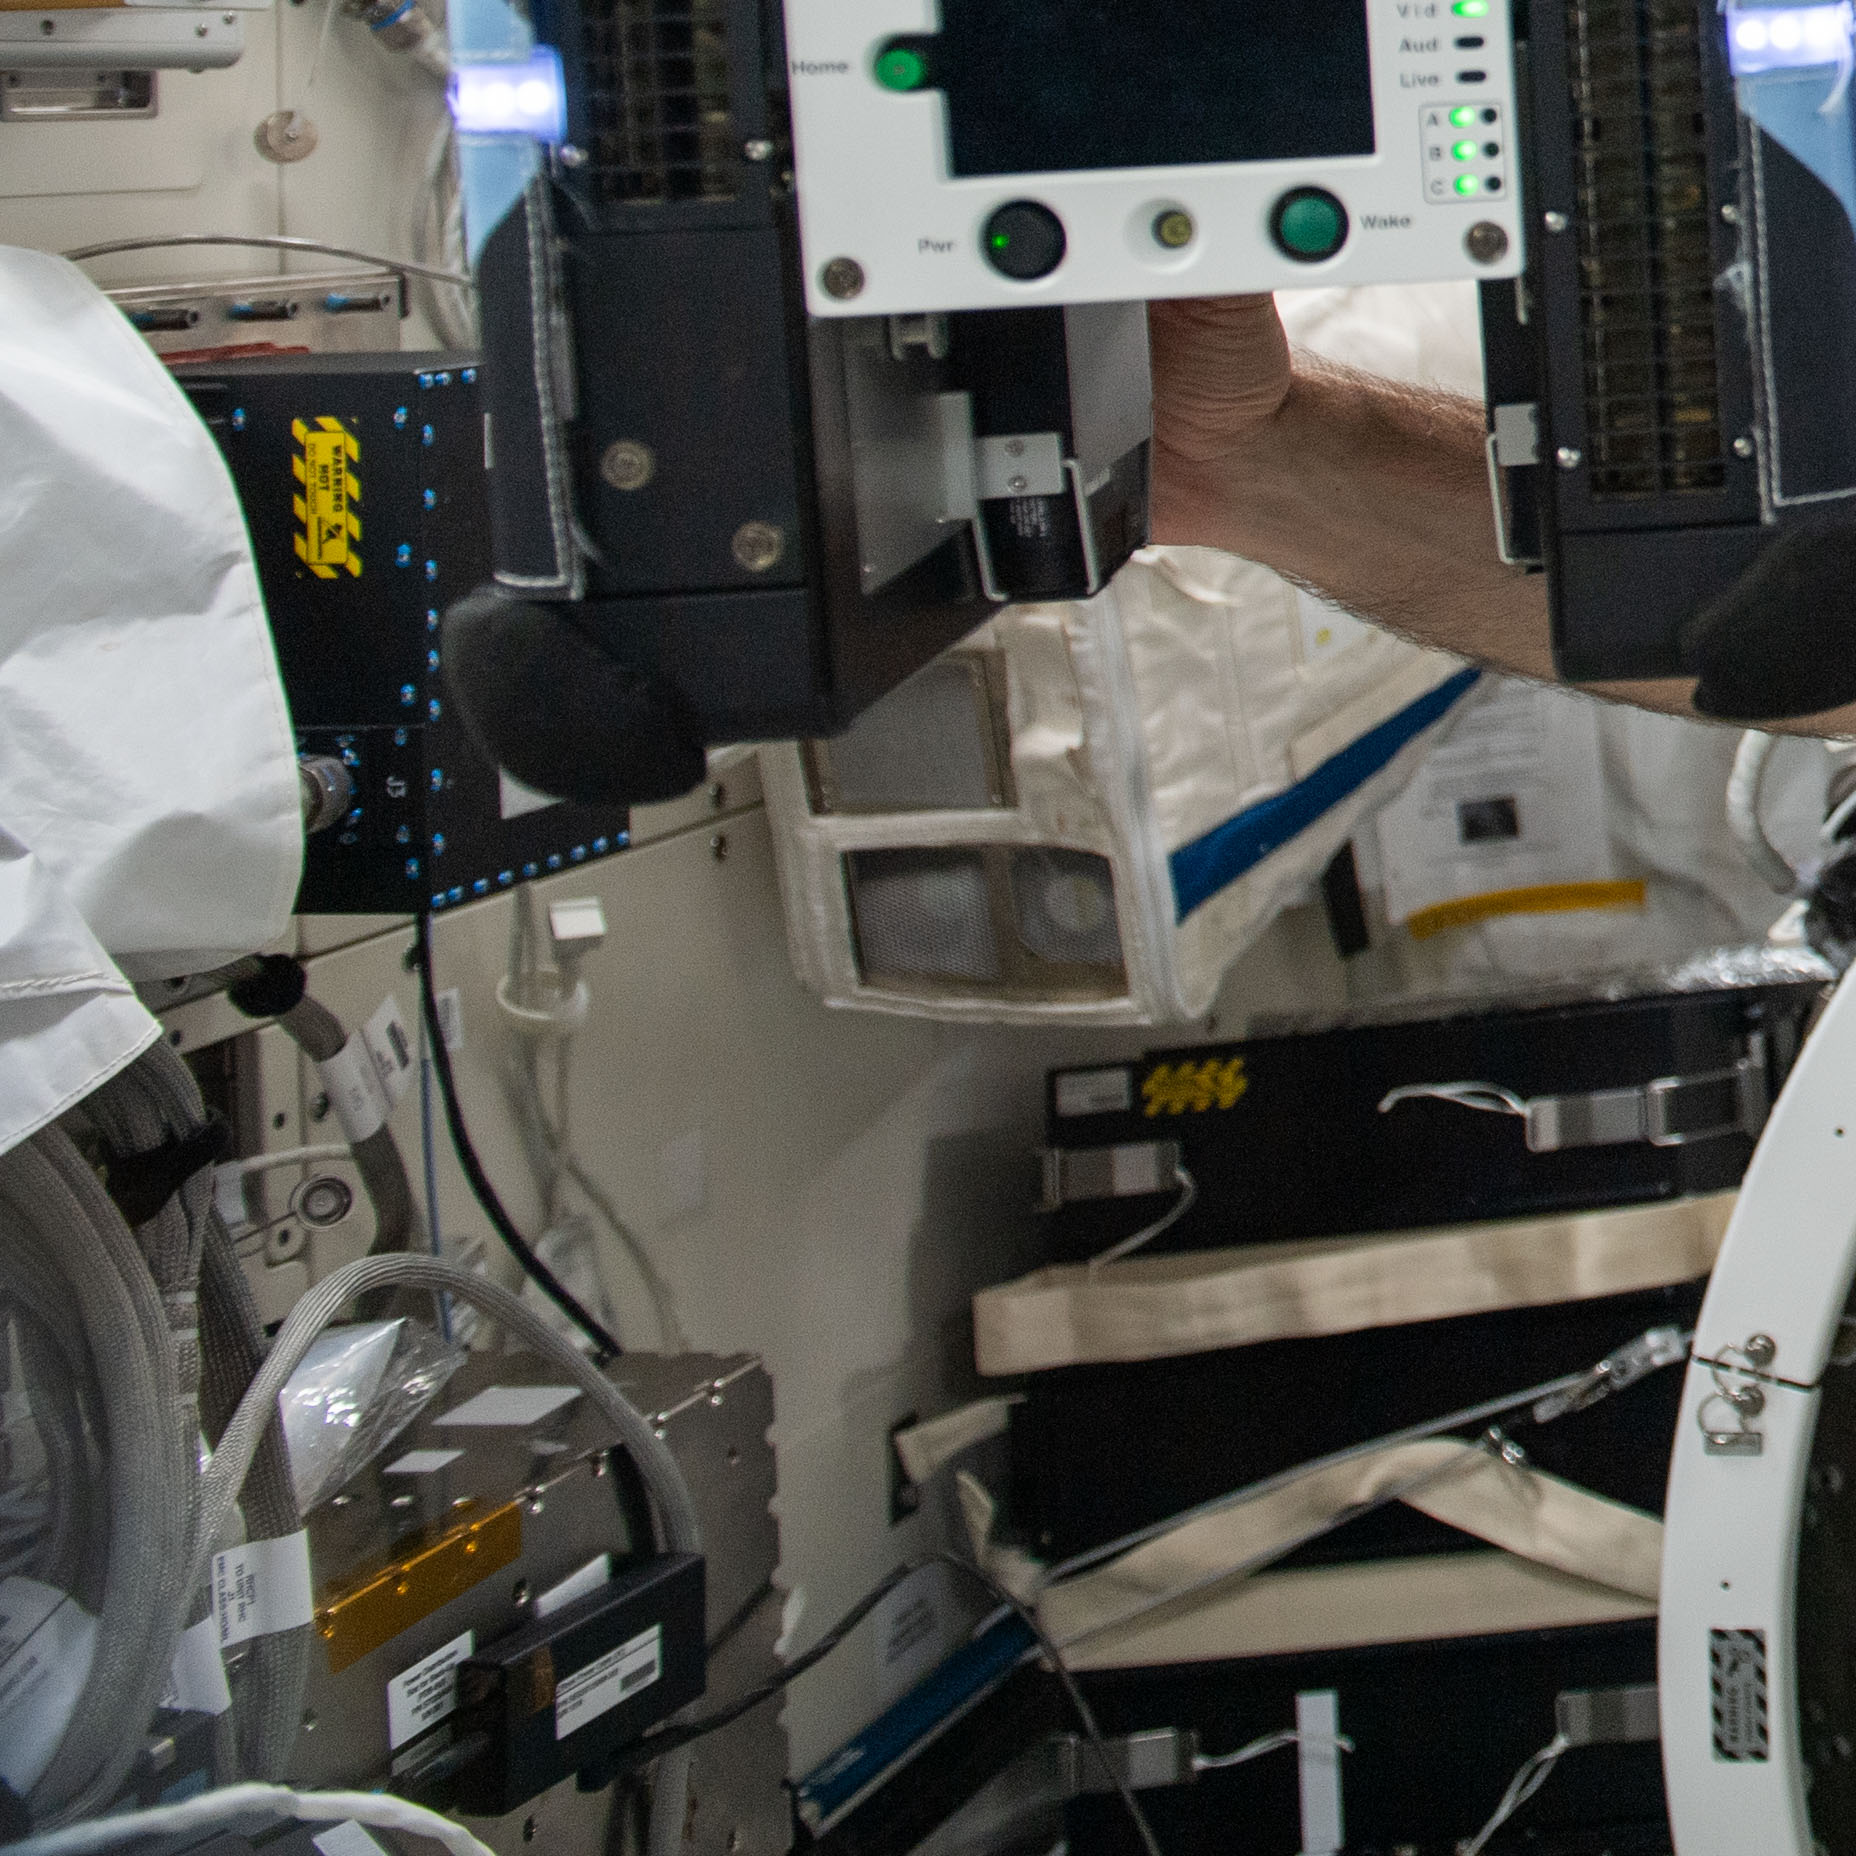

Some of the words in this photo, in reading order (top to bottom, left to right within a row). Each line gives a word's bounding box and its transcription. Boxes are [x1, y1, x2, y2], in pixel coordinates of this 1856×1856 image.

[1396, 3, 1438, 19] Vid
[1398, 37, 1439, 53] Aud
[790, 58, 850, 76] Home
[1398, 73, 1441, 89] Live
[1427, 112, 1439, 127] A
[1428, 146, 1442, 161] B
[1430, 180, 1445, 195] C
[1360, 212, 1413, 231] Wake
[918, 237, 956, 256] Pwr
[332, 444, 343, 513] WARNING
[385, 775, 408, 800] J3
